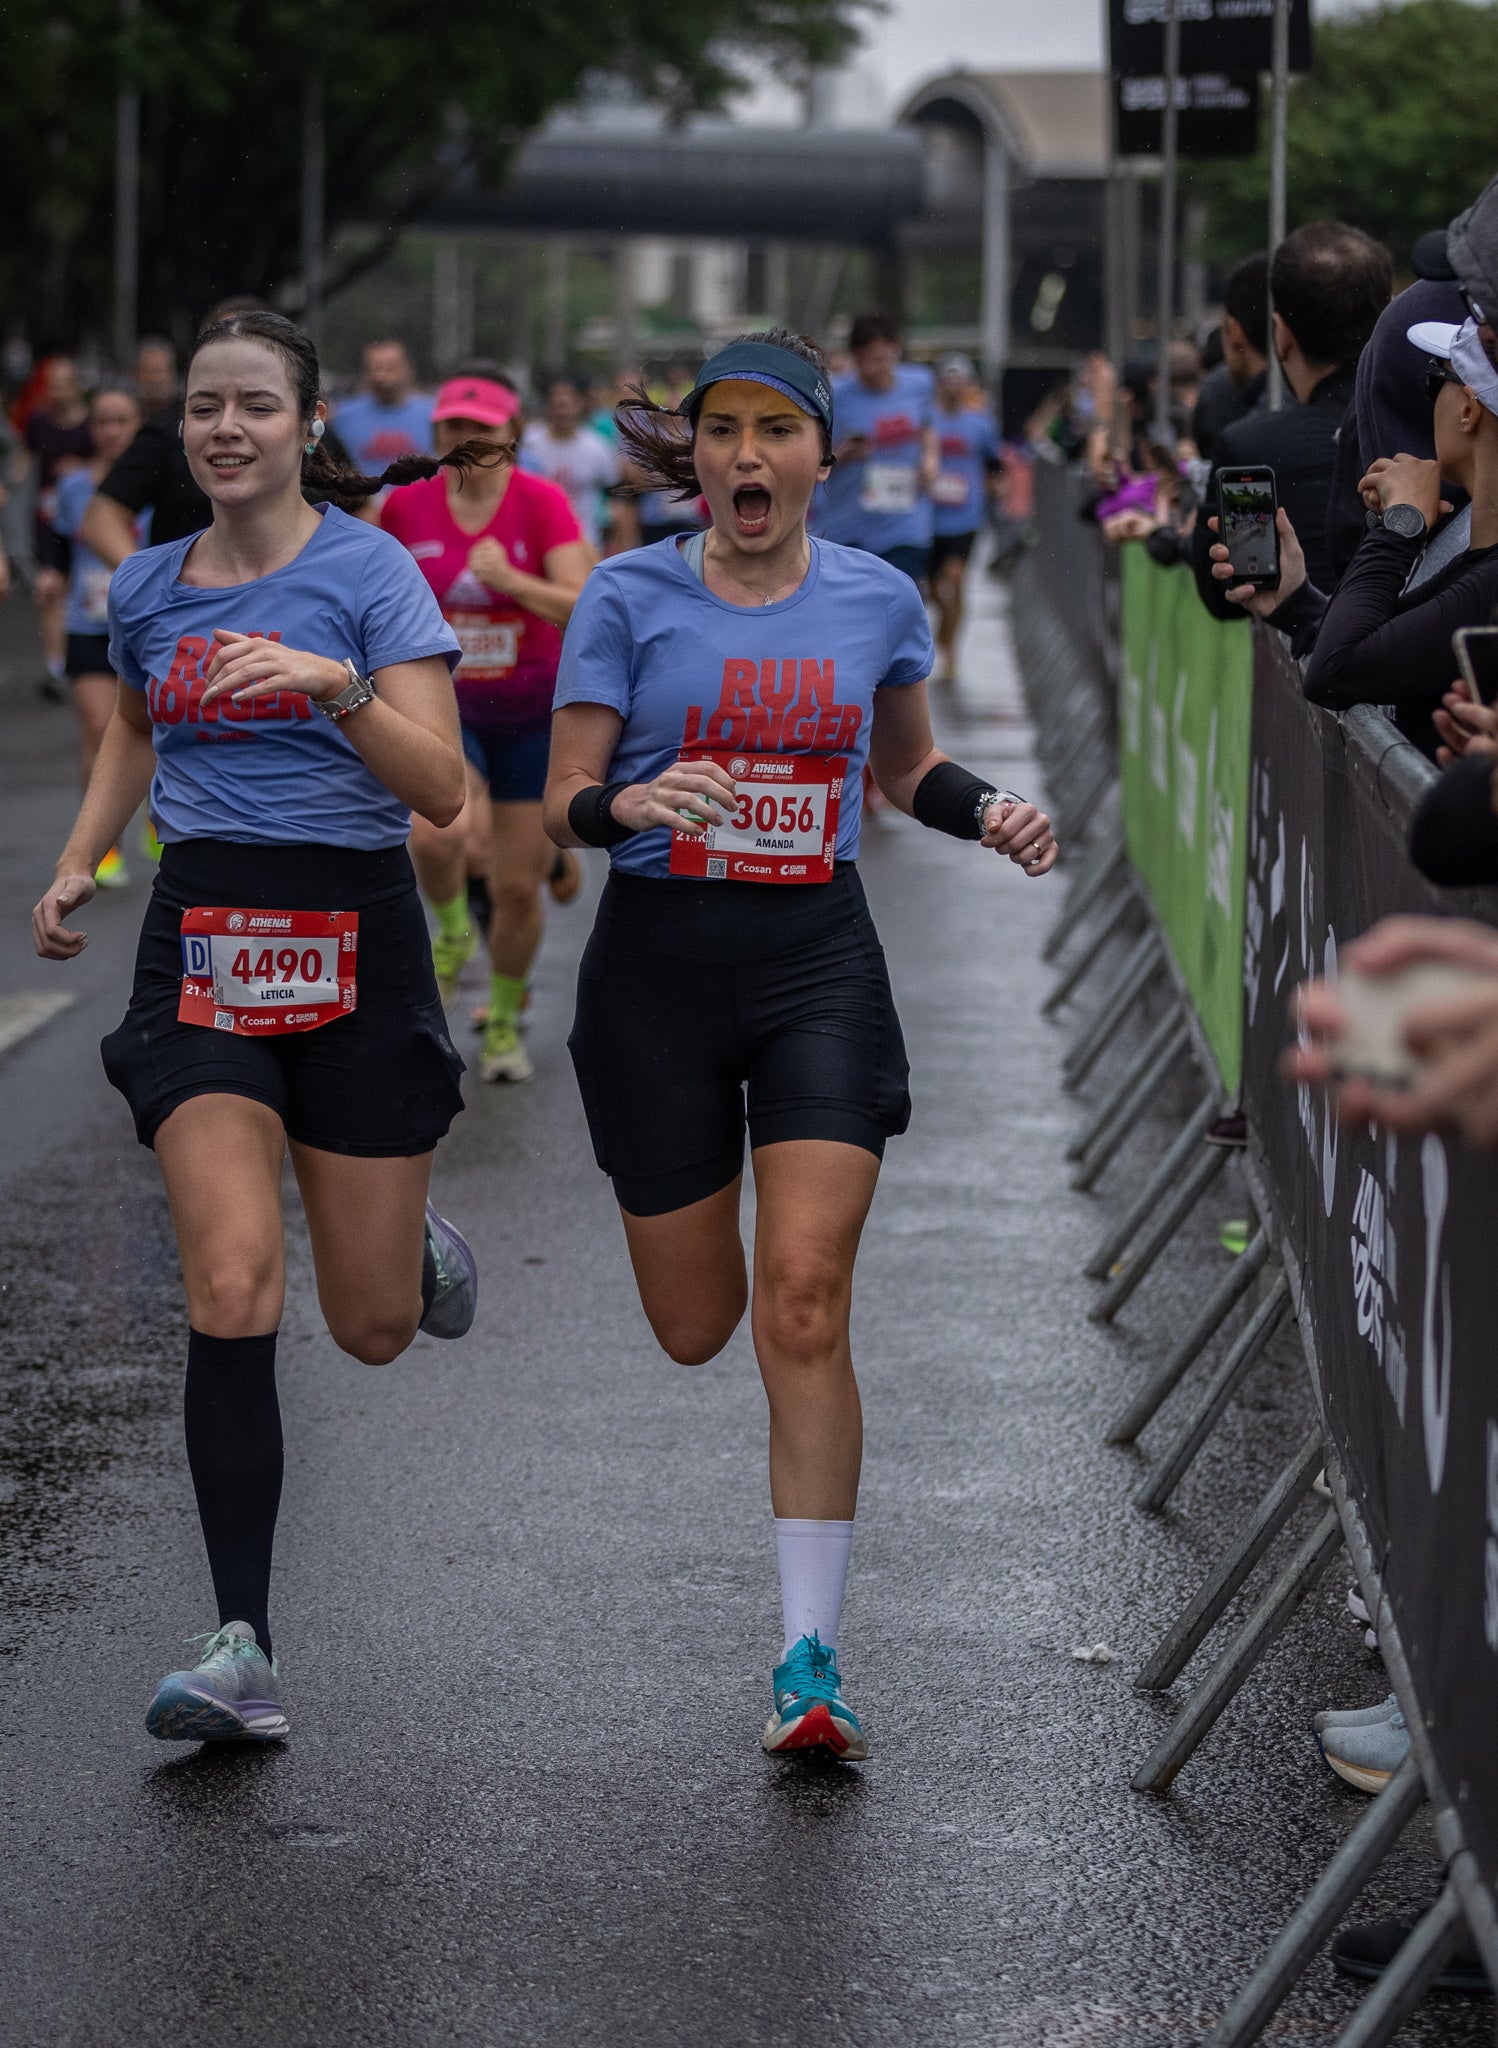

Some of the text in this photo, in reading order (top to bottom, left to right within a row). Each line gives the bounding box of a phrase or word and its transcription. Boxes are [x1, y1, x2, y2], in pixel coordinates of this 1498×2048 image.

[719, 658, 835, 708] RUN
[150, 678, 312, 725] LONGER
[681, 704, 863, 751] LONGER
[752, 763, 794, 775] ATHENAS
[829, 778, 840, 799] 3056
[731, 794, 814, 833] 3056
[755, 838, 794, 849] AMANDA
[823, 841, 832, 864] 3056
[743, 865, 772, 874] cosan
[249, 917, 292, 928] ATHENAS
[342, 932, 352, 952] 4490
[190, 940, 206, 971] D
[231, 948, 322, 984] 4490
[185, 984, 214, 999] 21.1K
[261, 989, 295, 1000] LETICIA
[342, 988, 351, 1009] 4490
[247, 1017, 276, 1026] cosan
